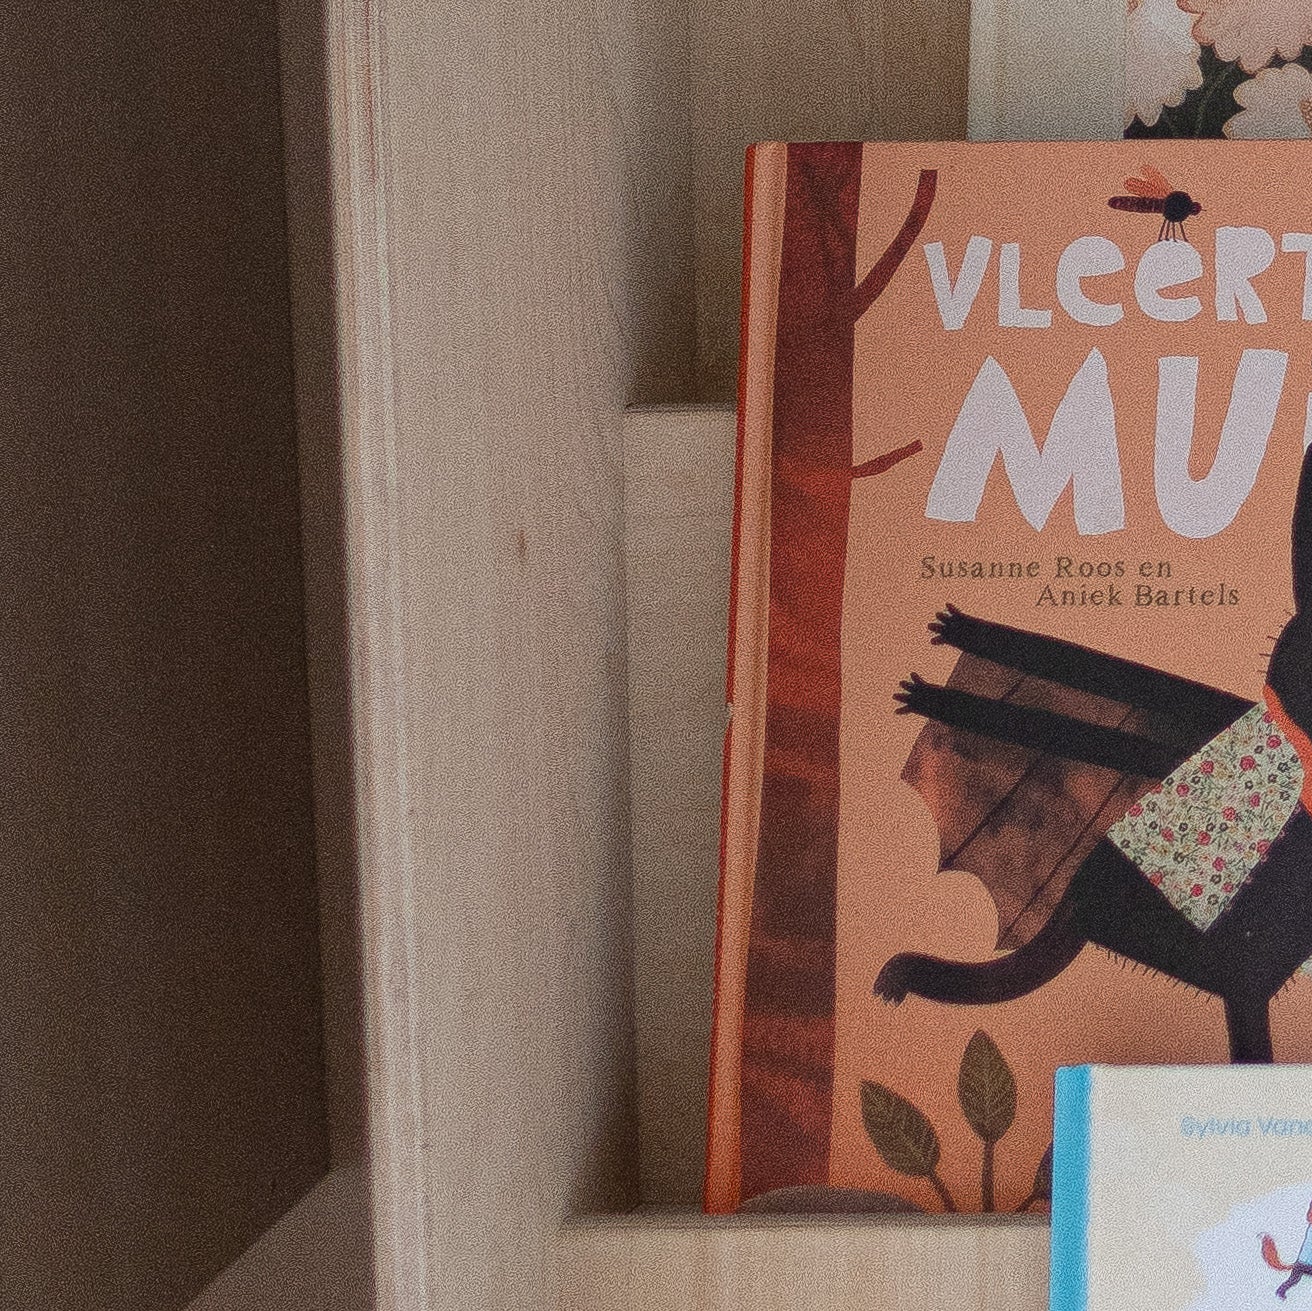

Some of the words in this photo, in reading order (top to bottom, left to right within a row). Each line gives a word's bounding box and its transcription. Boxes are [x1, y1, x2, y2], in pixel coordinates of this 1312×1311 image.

[920, 556, 1042, 581] Susanne
[1054, 556, 1127, 581] Roos
[1139, 560, 1173, 580] en
[1036, 582, 1124, 608] Aniek
[1134, 583, 1241, 608] Bartels
[1180, 1115, 1250, 1139] Sylvia
